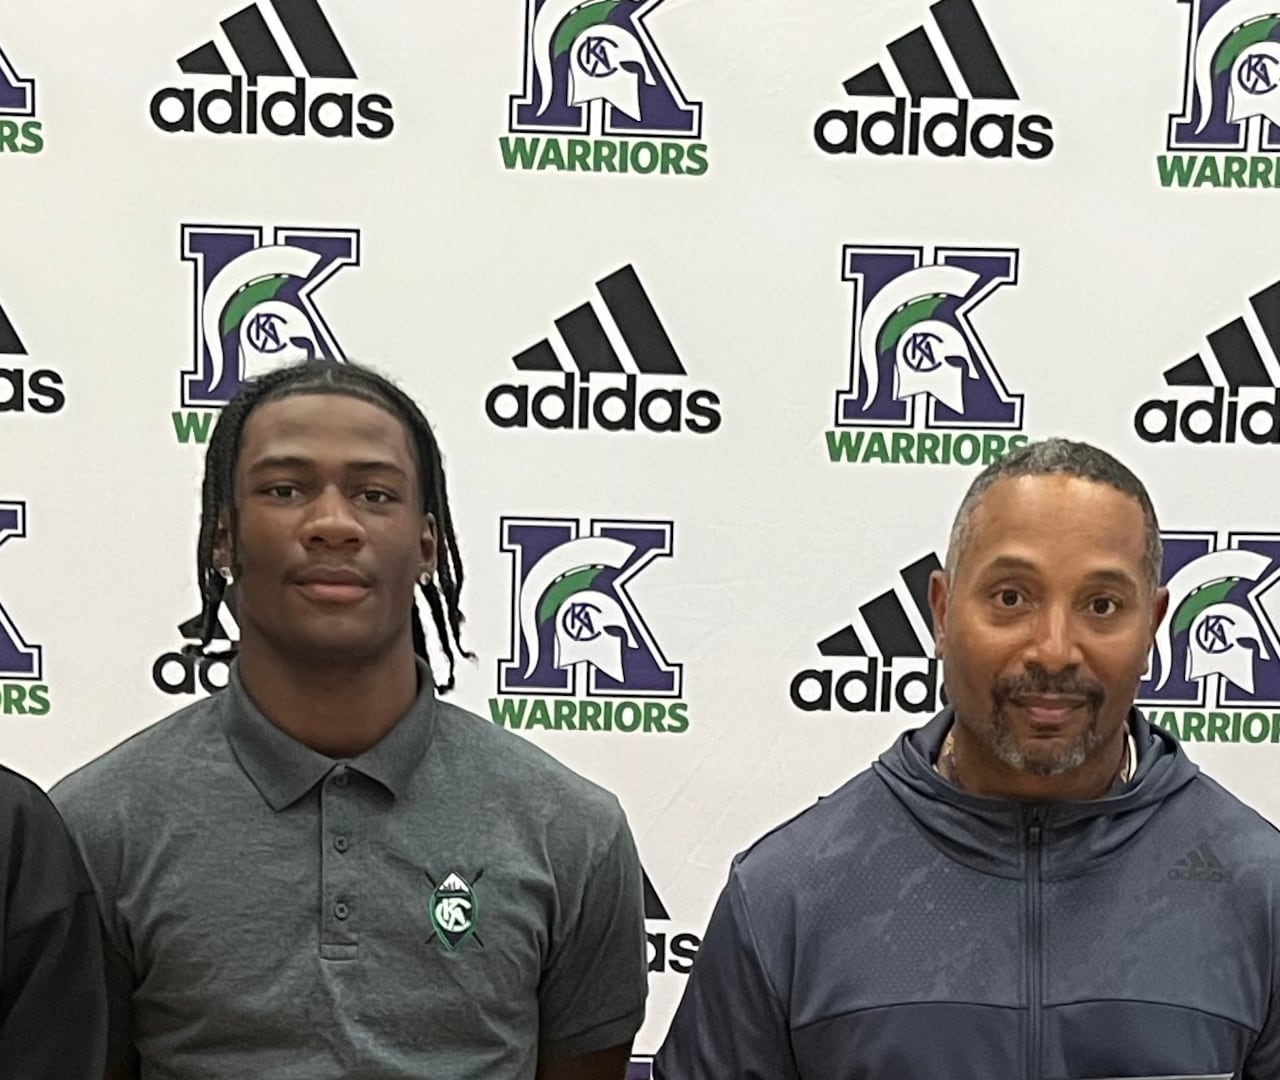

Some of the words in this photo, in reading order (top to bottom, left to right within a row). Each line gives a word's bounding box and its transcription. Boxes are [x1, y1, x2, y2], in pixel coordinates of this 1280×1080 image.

[150, 74, 394, 139] adidas
[814, 97, 1054, 159] adidas
[499, 135, 709, 176] WARRIORS
[485, 371, 721, 434] adidas
[790, 657, 952, 714] adid
[489, 698, 689, 734] WARRIORS
